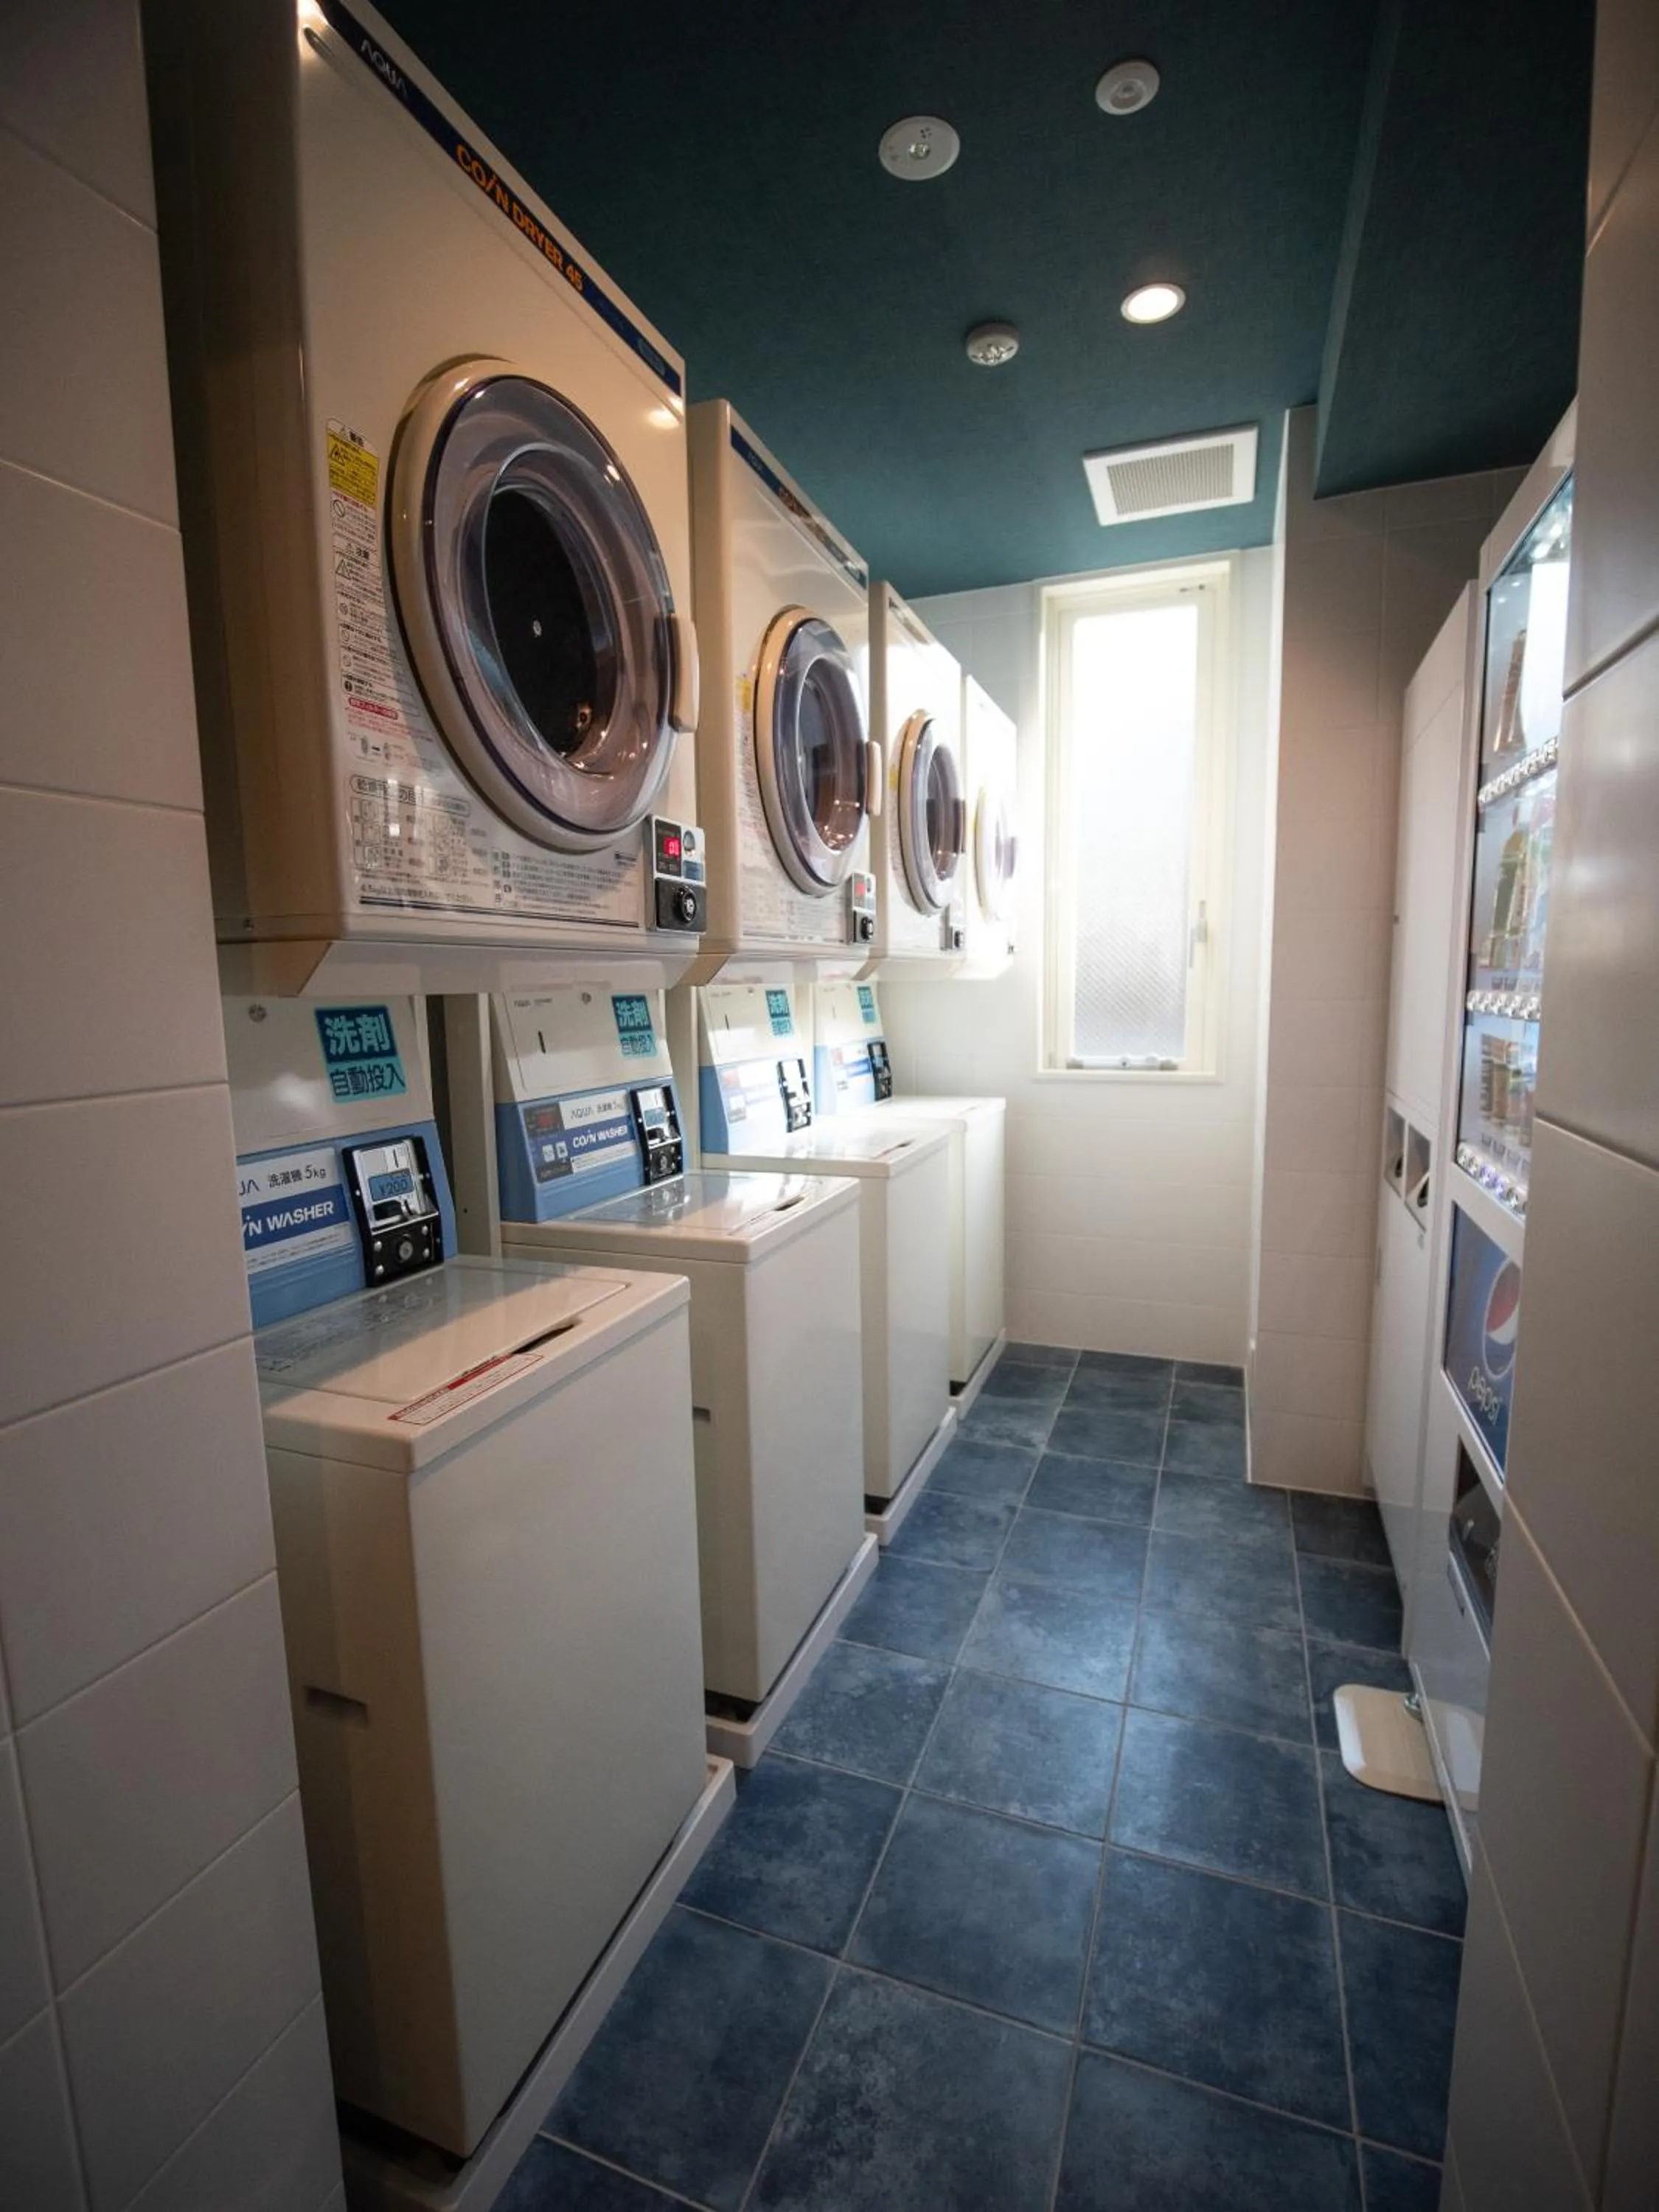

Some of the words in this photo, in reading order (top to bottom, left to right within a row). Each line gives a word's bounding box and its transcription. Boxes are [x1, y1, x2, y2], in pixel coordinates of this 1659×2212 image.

[361, 39, 408, 99] AQUA
[456, 144, 509, 213] COIN
[512, 201, 564, 272] DRYER
[615, 1000, 650, 1028] 洗剤
[325, 1014, 390, 1054] 洗剤
[330, 1062, 406, 1097] 自動投入
[573, 1129, 597, 1148] COIN
[597, 1124, 628, 1142] WASHER
[305, 1164, 327, 1180] 5kg
[266, 1201, 335, 1232] WASHER
